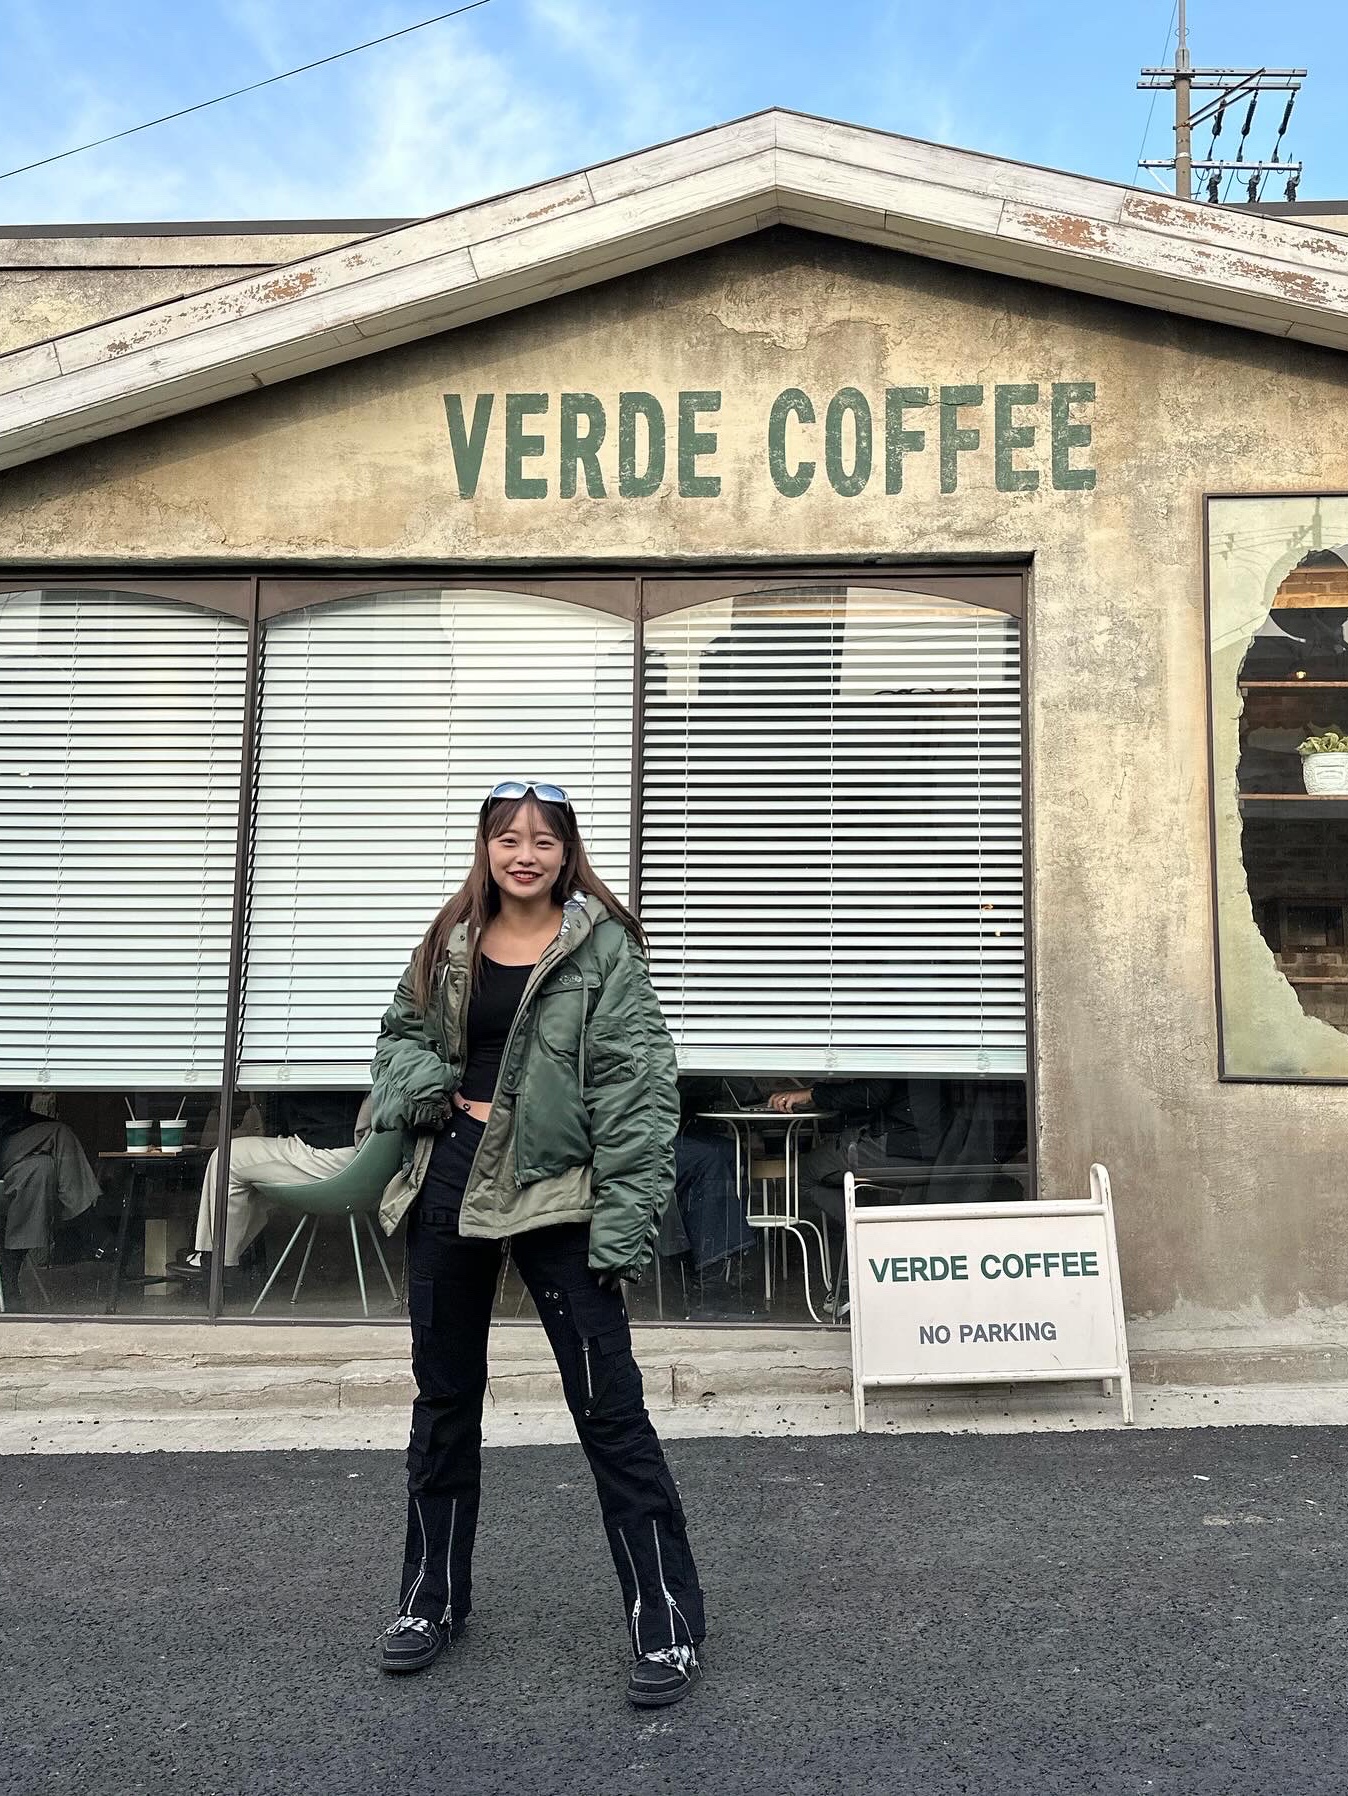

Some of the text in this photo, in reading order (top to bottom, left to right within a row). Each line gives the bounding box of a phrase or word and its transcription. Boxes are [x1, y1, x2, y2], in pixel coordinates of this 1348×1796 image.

[444, 382, 1096, 499] VERDE COFFEE
[869, 1251, 1099, 1283] VERDE COFFEE
[919, 1321, 1057, 1345] NO PARKING
